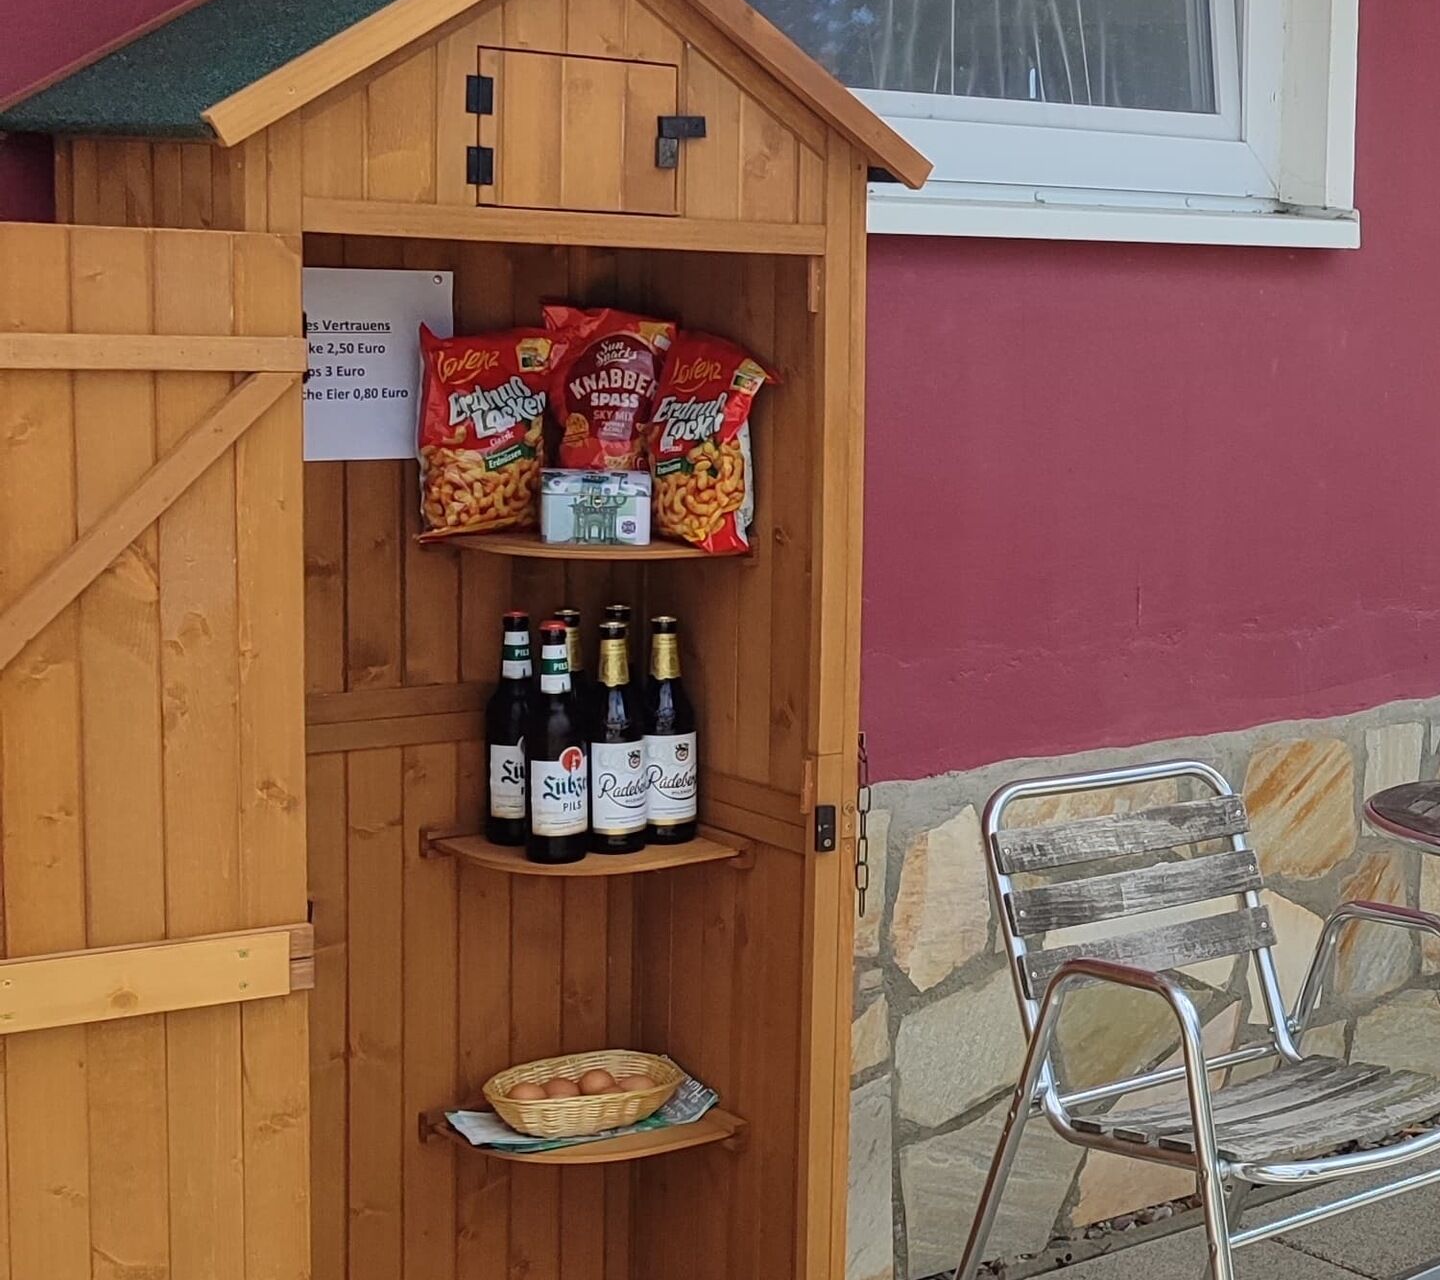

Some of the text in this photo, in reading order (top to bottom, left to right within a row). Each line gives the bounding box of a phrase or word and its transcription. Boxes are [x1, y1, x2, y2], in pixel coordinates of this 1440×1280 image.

[322, 320, 391, 331] Vertrauens
[327, 343, 354, 356] 2,50
[357, 344, 386, 354] Euro
[601, 341, 624, 354] Sun
[596, 347, 637, 367] Snacks
[325, 366, 333, 377] 3
[336, 366, 366, 377] Euro
[438, 349, 499, 384] Lorenz
[671, 358, 722, 385] Lorenz
[326, 389, 350, 400] Eier
[353, 388, 378, 401] 0,80
[381, 388, 409, 399] Euro
[591, 392, 639, 408] SPASS
[471, 391, 546, 438] Locken
[563, 801, 582, 812] PILS
